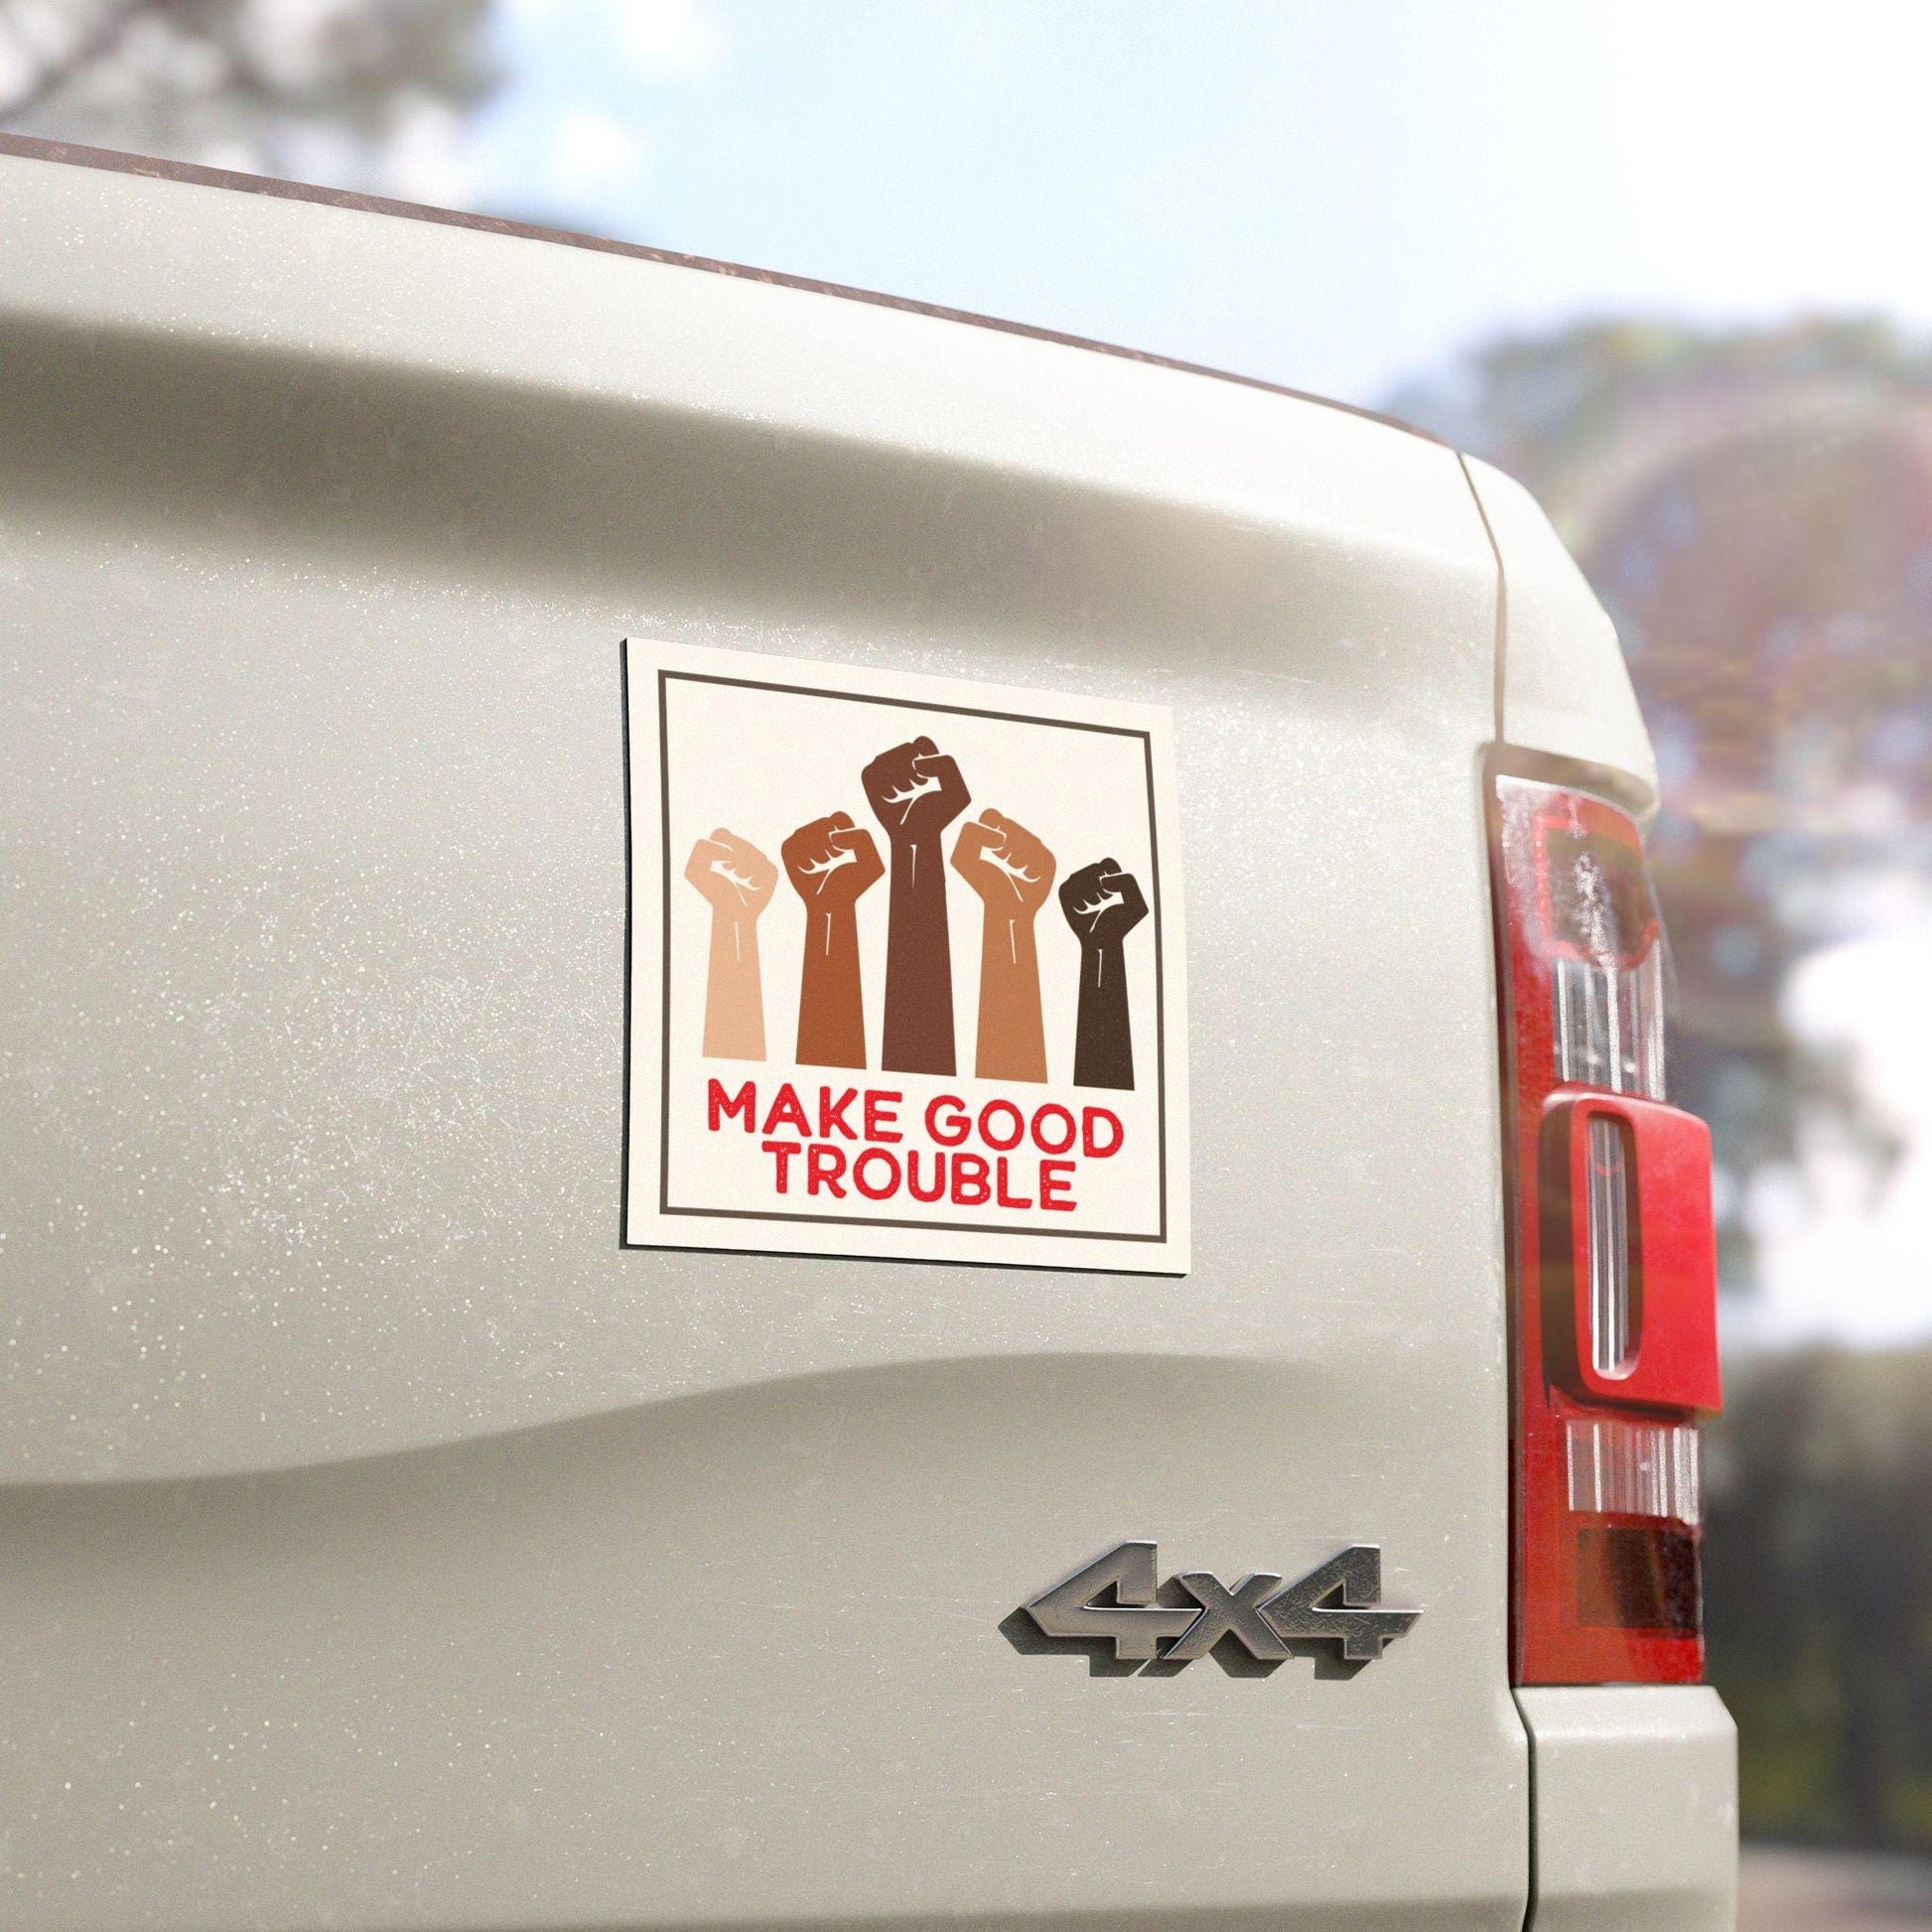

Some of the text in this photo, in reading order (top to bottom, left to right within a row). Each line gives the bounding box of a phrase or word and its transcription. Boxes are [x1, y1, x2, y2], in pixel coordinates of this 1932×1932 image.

[707, 1078, 1125, 1159] MAKE GOOD
[761, 1140, 1077, 1212] TROUBLE
